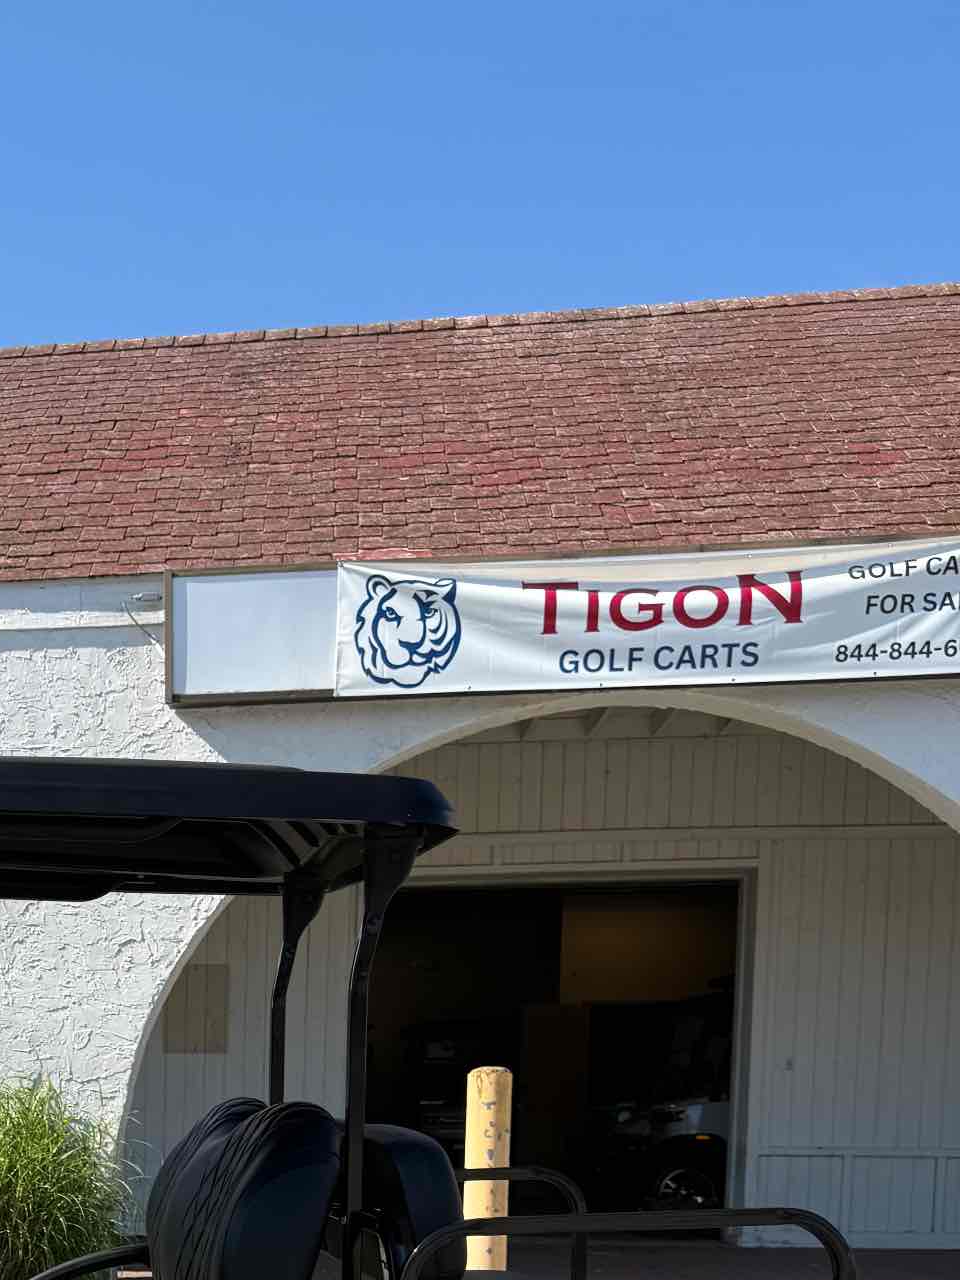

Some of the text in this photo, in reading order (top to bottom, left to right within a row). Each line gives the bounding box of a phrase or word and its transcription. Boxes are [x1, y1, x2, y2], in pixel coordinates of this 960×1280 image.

[847, 559, 918, 579] GOLF
[521, 570, 807, 635] TIGON
[865, 592, 960, 615] FOR SA
[558, 642, 760, 674] GOLF CARTS
[834, 639, 960, 662] 844-844-6
